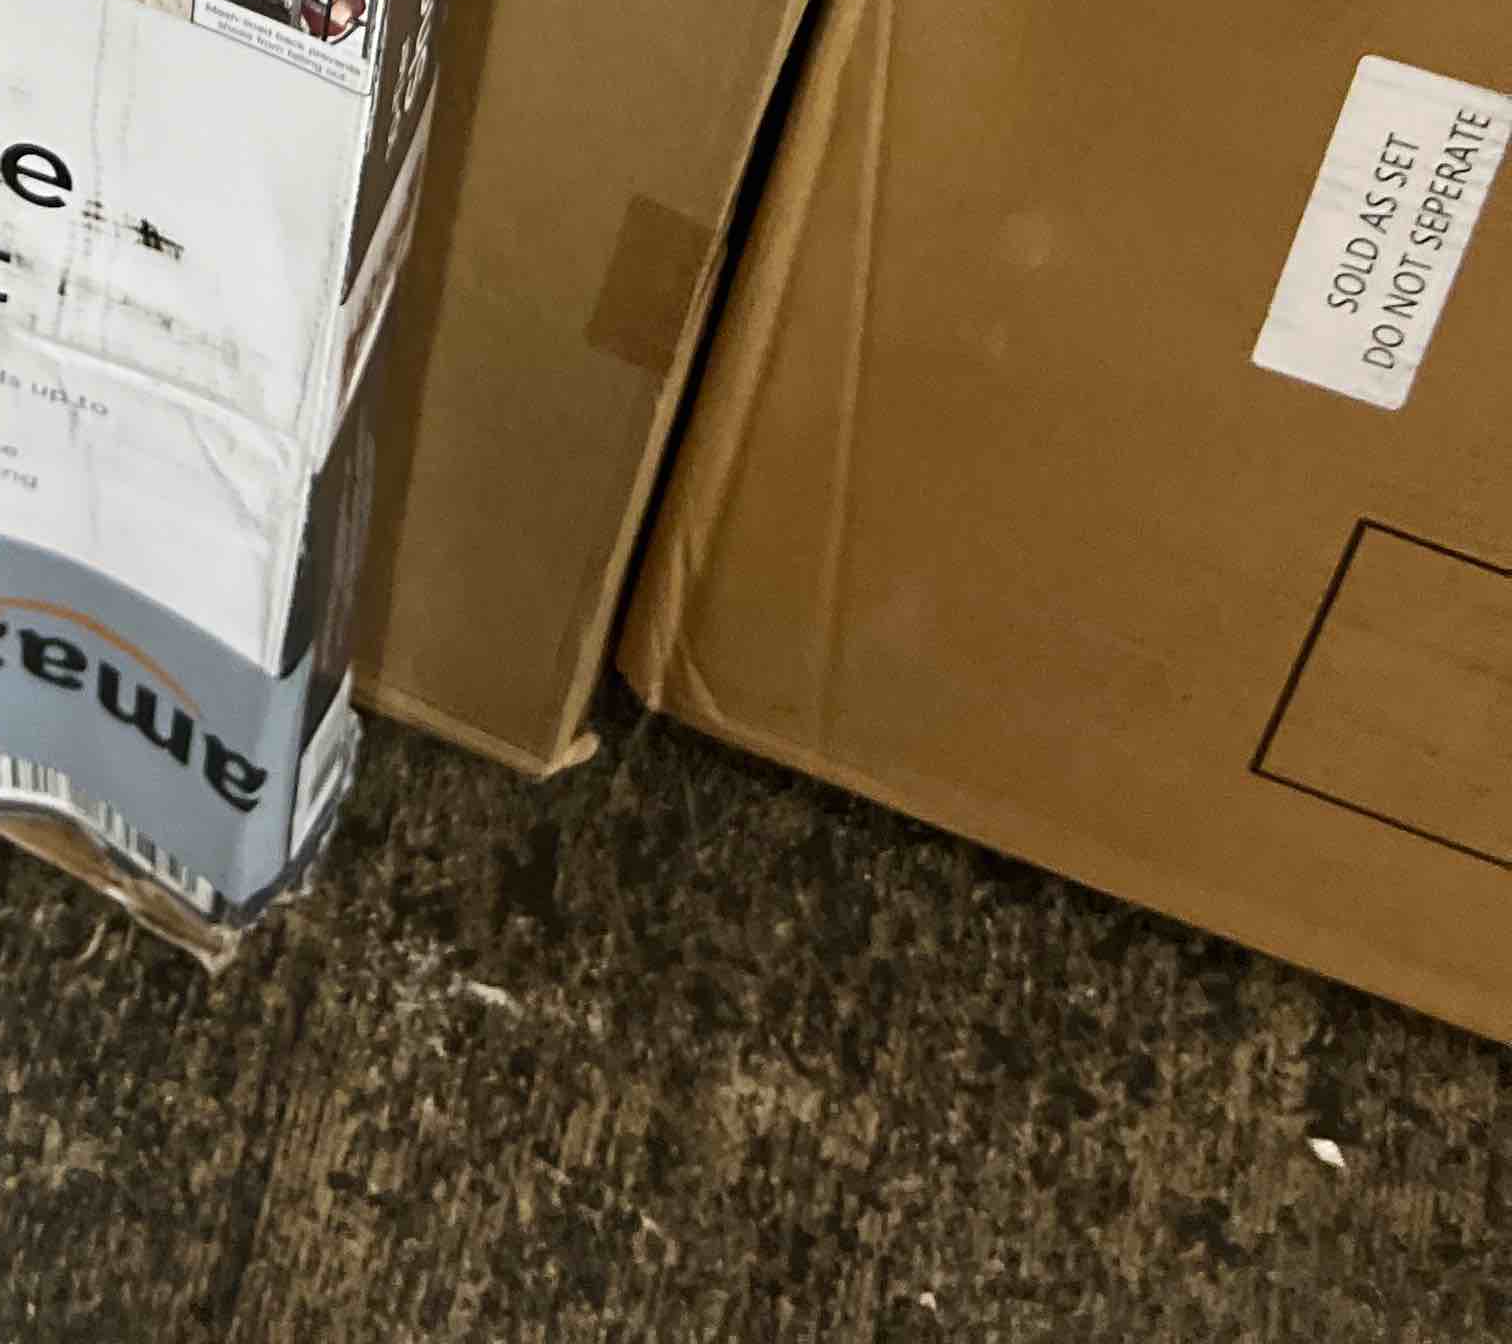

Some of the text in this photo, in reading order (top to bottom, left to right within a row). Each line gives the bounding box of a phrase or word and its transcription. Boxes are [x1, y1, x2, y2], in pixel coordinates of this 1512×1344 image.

[1327, 131, 1421, 315] SOLD AS SET
[1361, 107, 1492, 371] DO NOT SEPERATE
